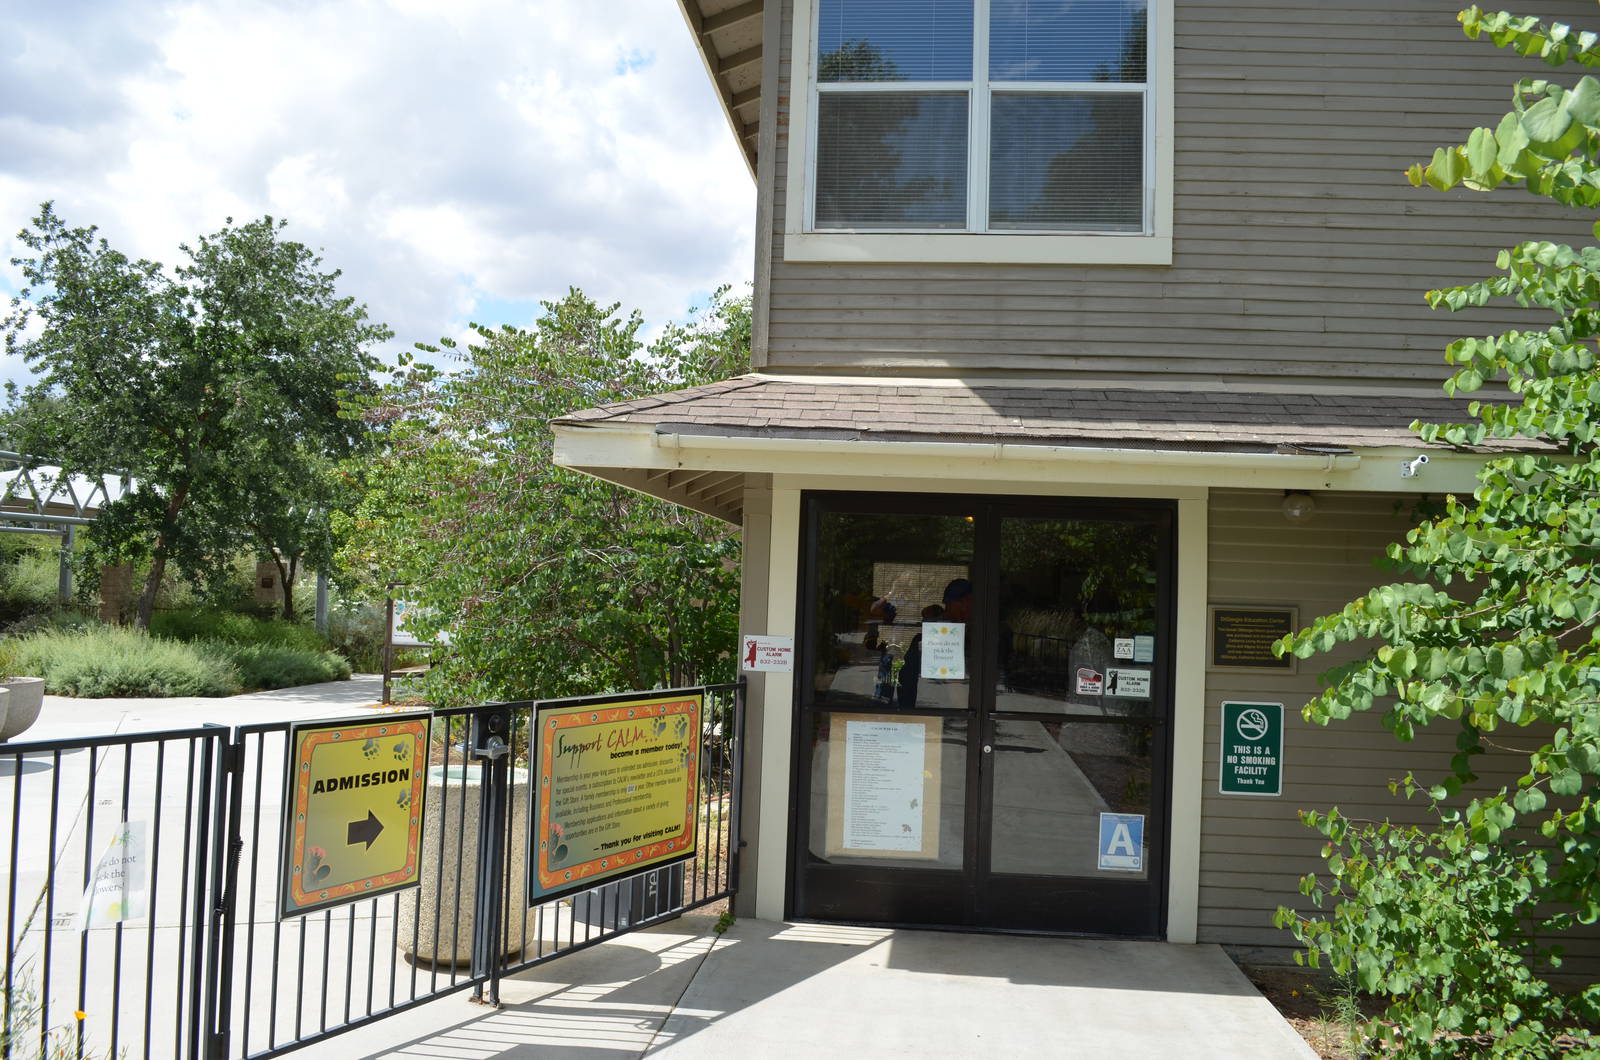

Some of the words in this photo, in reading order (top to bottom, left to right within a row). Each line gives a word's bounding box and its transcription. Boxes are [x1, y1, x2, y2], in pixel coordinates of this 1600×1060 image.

[556, 732, 603, 768] Support
[610, 748, 634, 760] become
[640, 744, 664, 754] member
[665, 741, 683, 752] today!
[1233, 746, 1251, 754] THIS
[1254, 746, 1262, 754] IS
[1265, 747, 1270, 755] A
[1227, 755, 1238, 764] NO
[1241, 756, 1276, 765] SMOKING
[1234, 766, 1267, 775] FACILITY
[313, 768, 410, 794] ADMISSION
[601, 840, 620, 850] Thank
[620, 837, 632, 846] you
[643, 830, 664, 840] visiting
[665, 824, 681, 834] CALM!
[1107, 824, 1135, 855] A
[108, 856, 119, 866] do
[121, 854, 136, 865] not
[111, 868, 126, 879] the
